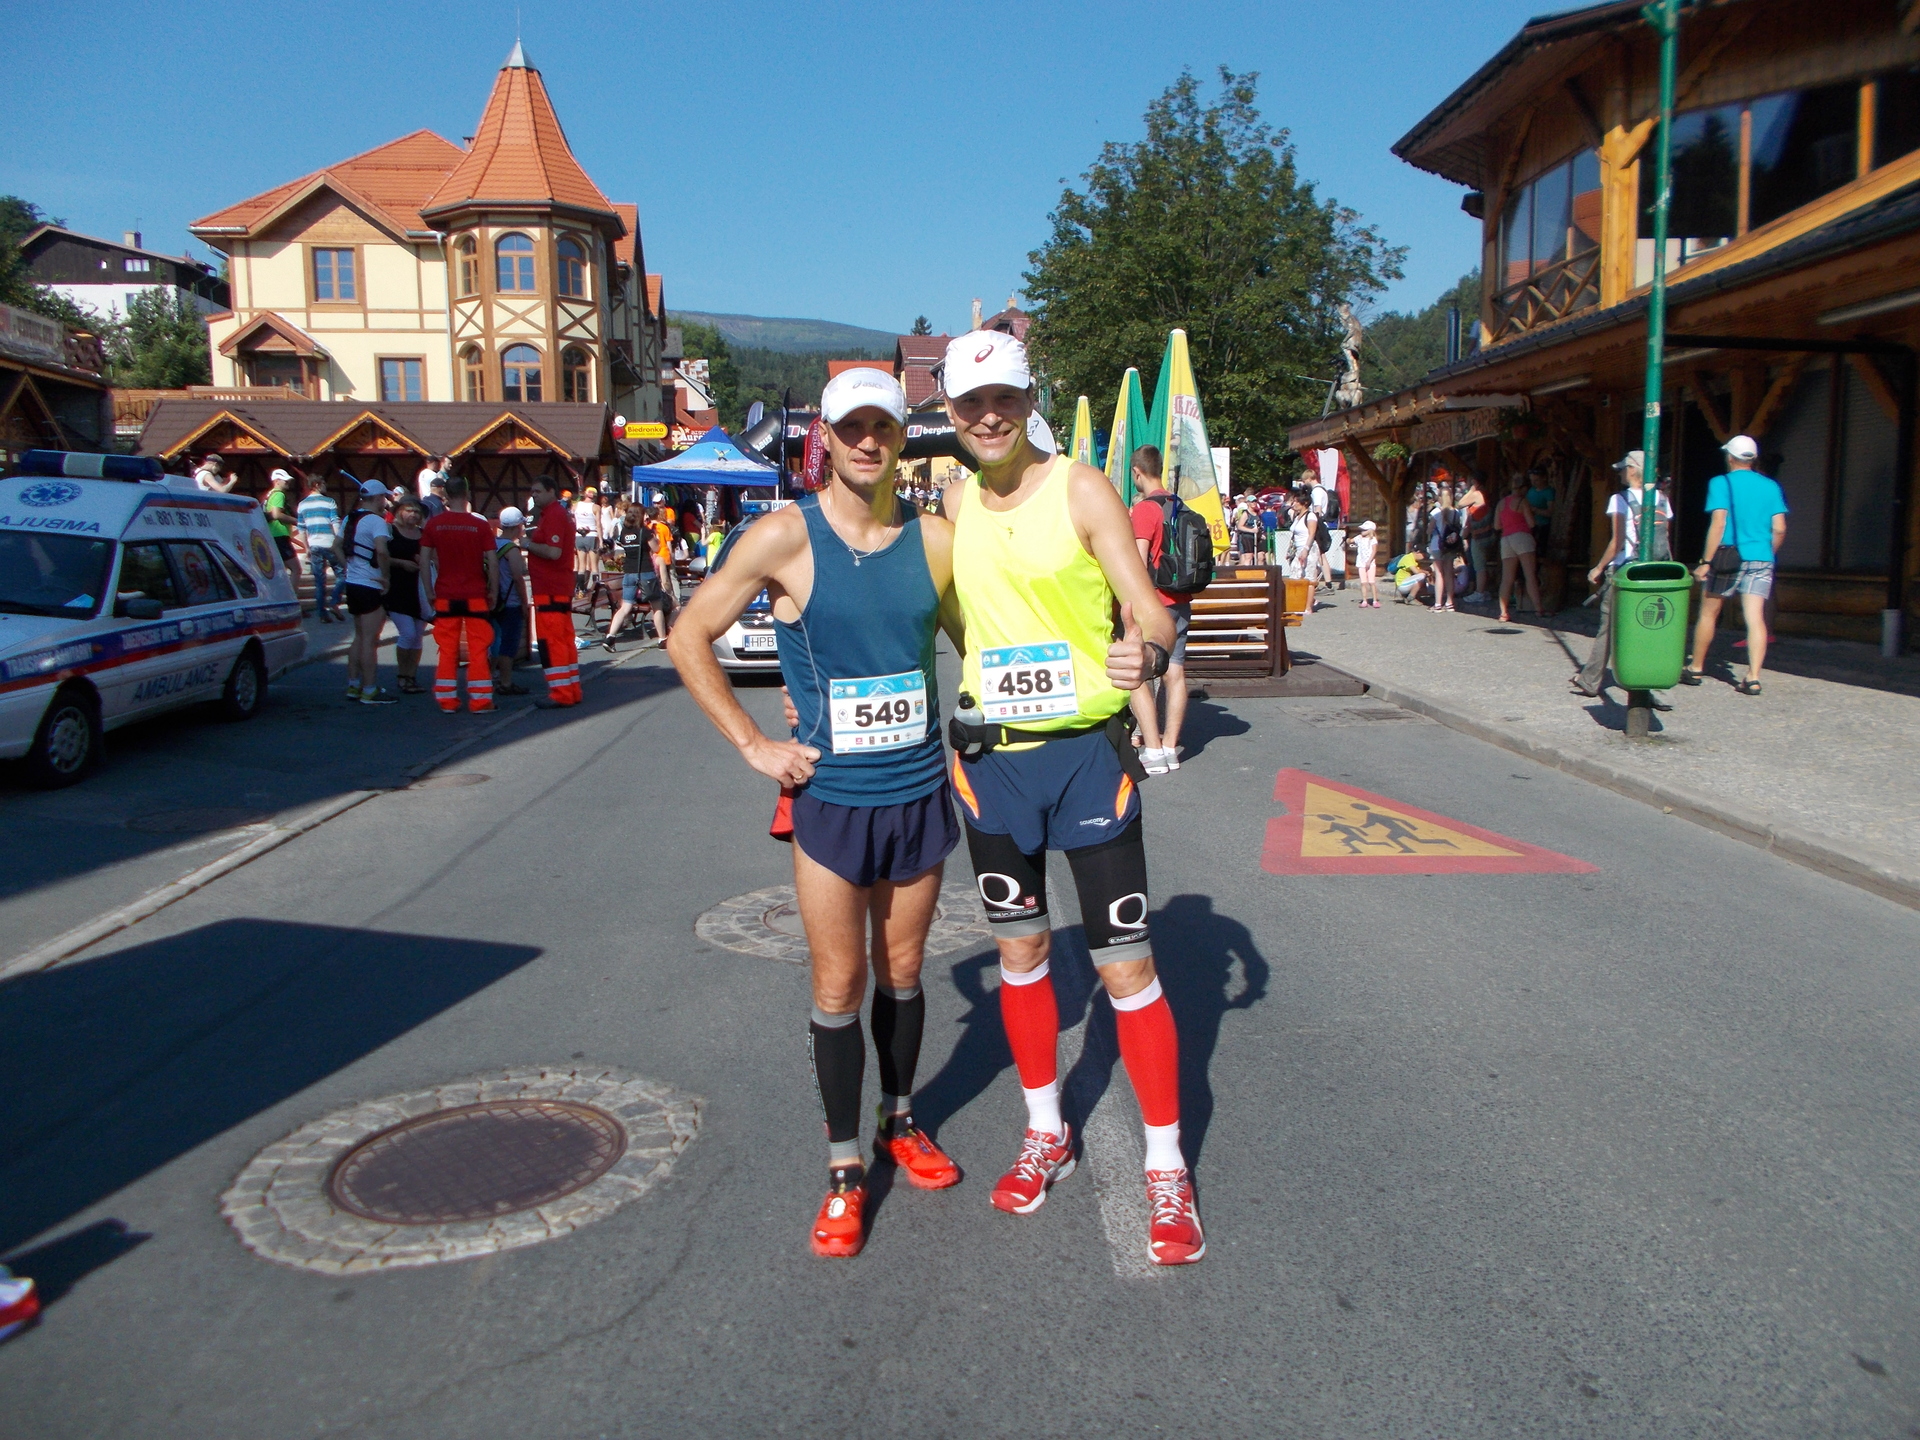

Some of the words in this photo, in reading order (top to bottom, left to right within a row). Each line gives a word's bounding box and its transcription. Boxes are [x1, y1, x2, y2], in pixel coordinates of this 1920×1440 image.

[923, 425, 956, 436] berghau
[751, 636, 775, 647] HPB
[131, 662, 219, 704] AMBULANCE
[998, 668, 1053, 696] 458
[855, 699, 910, 728] 549
[1079, 817, 1103, 826] saucony
